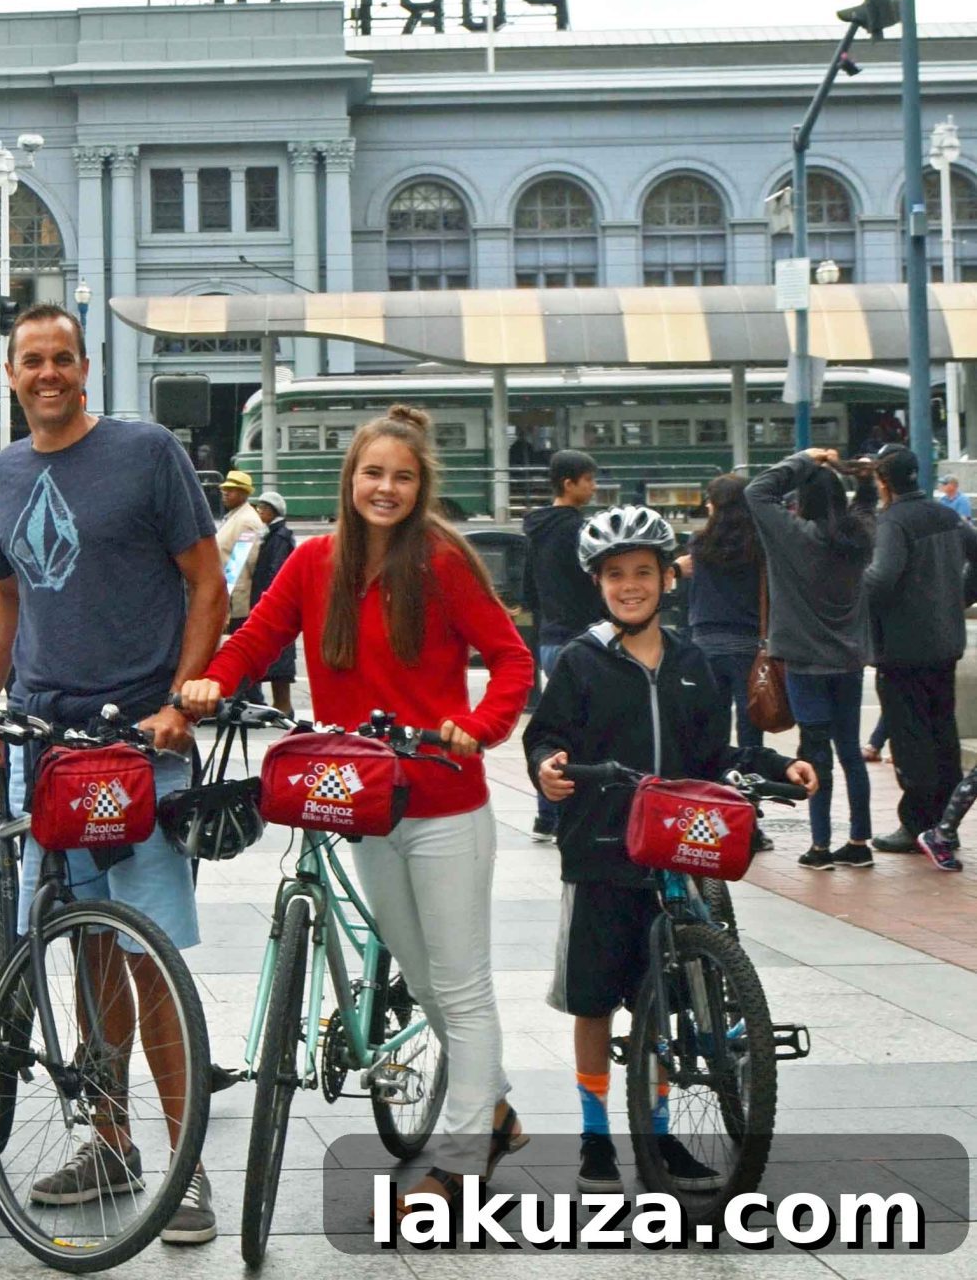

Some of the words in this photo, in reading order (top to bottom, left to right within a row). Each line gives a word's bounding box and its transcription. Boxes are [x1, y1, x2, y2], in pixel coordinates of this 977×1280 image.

[305, 800, 353, 816] Alcatraz
[85, 823, 125, 834] Alcatraz
[677, 843, 721, 861] Alcatraz
